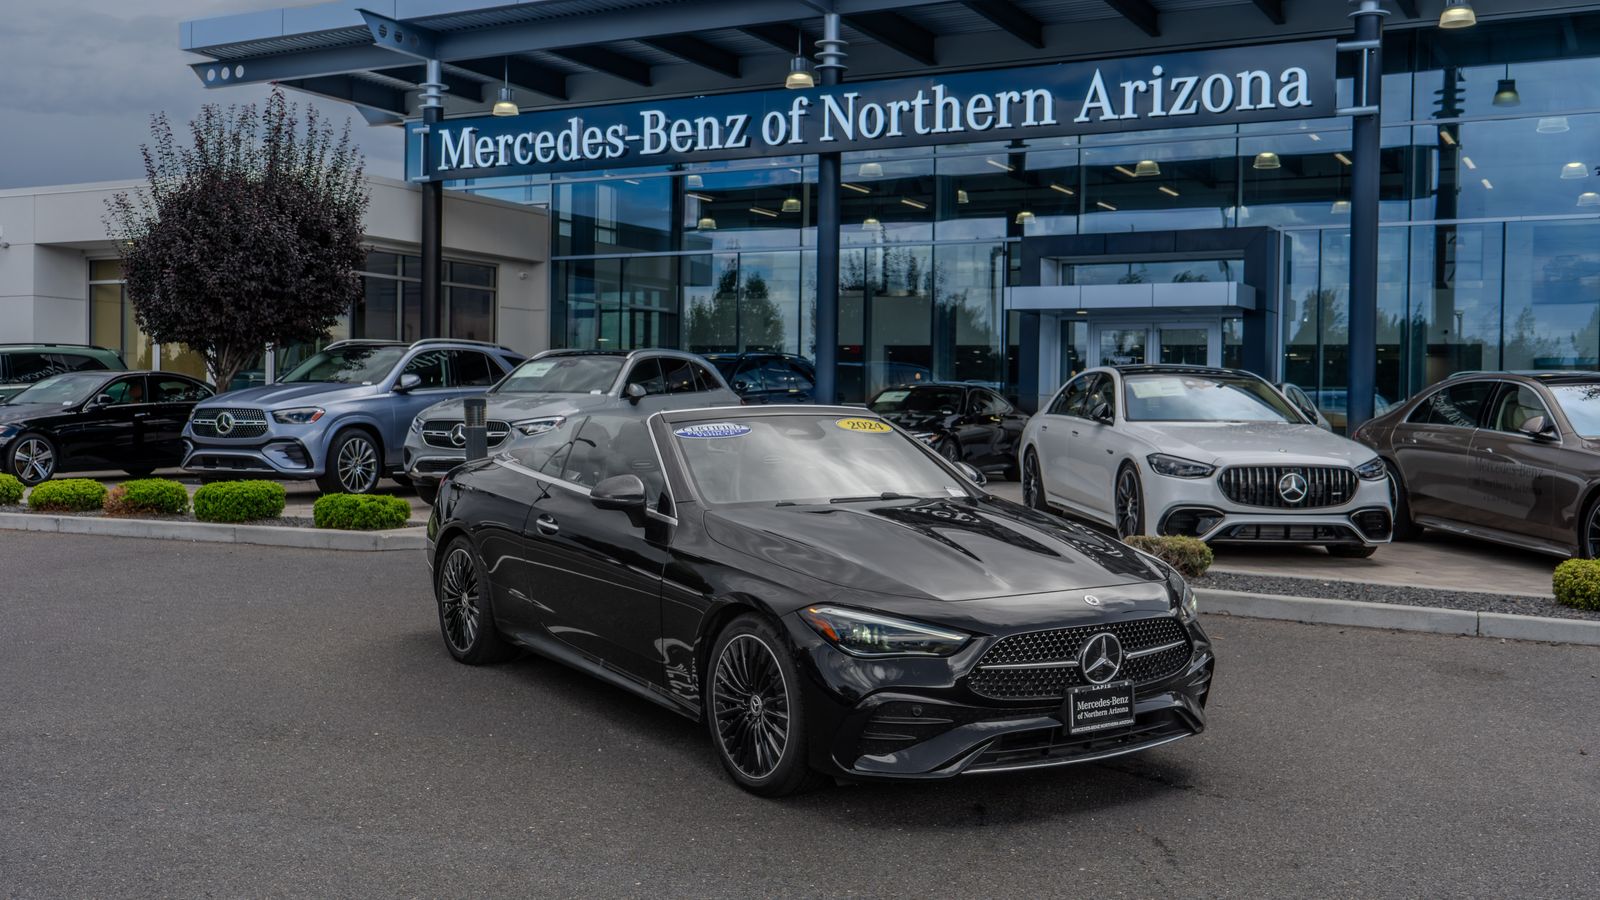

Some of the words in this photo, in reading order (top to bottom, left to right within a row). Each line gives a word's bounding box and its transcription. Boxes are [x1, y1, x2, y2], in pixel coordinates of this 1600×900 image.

[437, 109, 749, 171] Mercedes-Benz
[761, 96, 809, 146] of
[819, 84, 1057, 142] Northern
[1073, 65, 1313, 123] Arizona
[846, 420, 884, 430] 2024
[1077, 696, 1129, 710] Mercedes-Benz
[1077, 711, 1083, 720] of
[1083, 710, 1108, 719] Northern
[1108, 706, 1129, 715] Arizona
